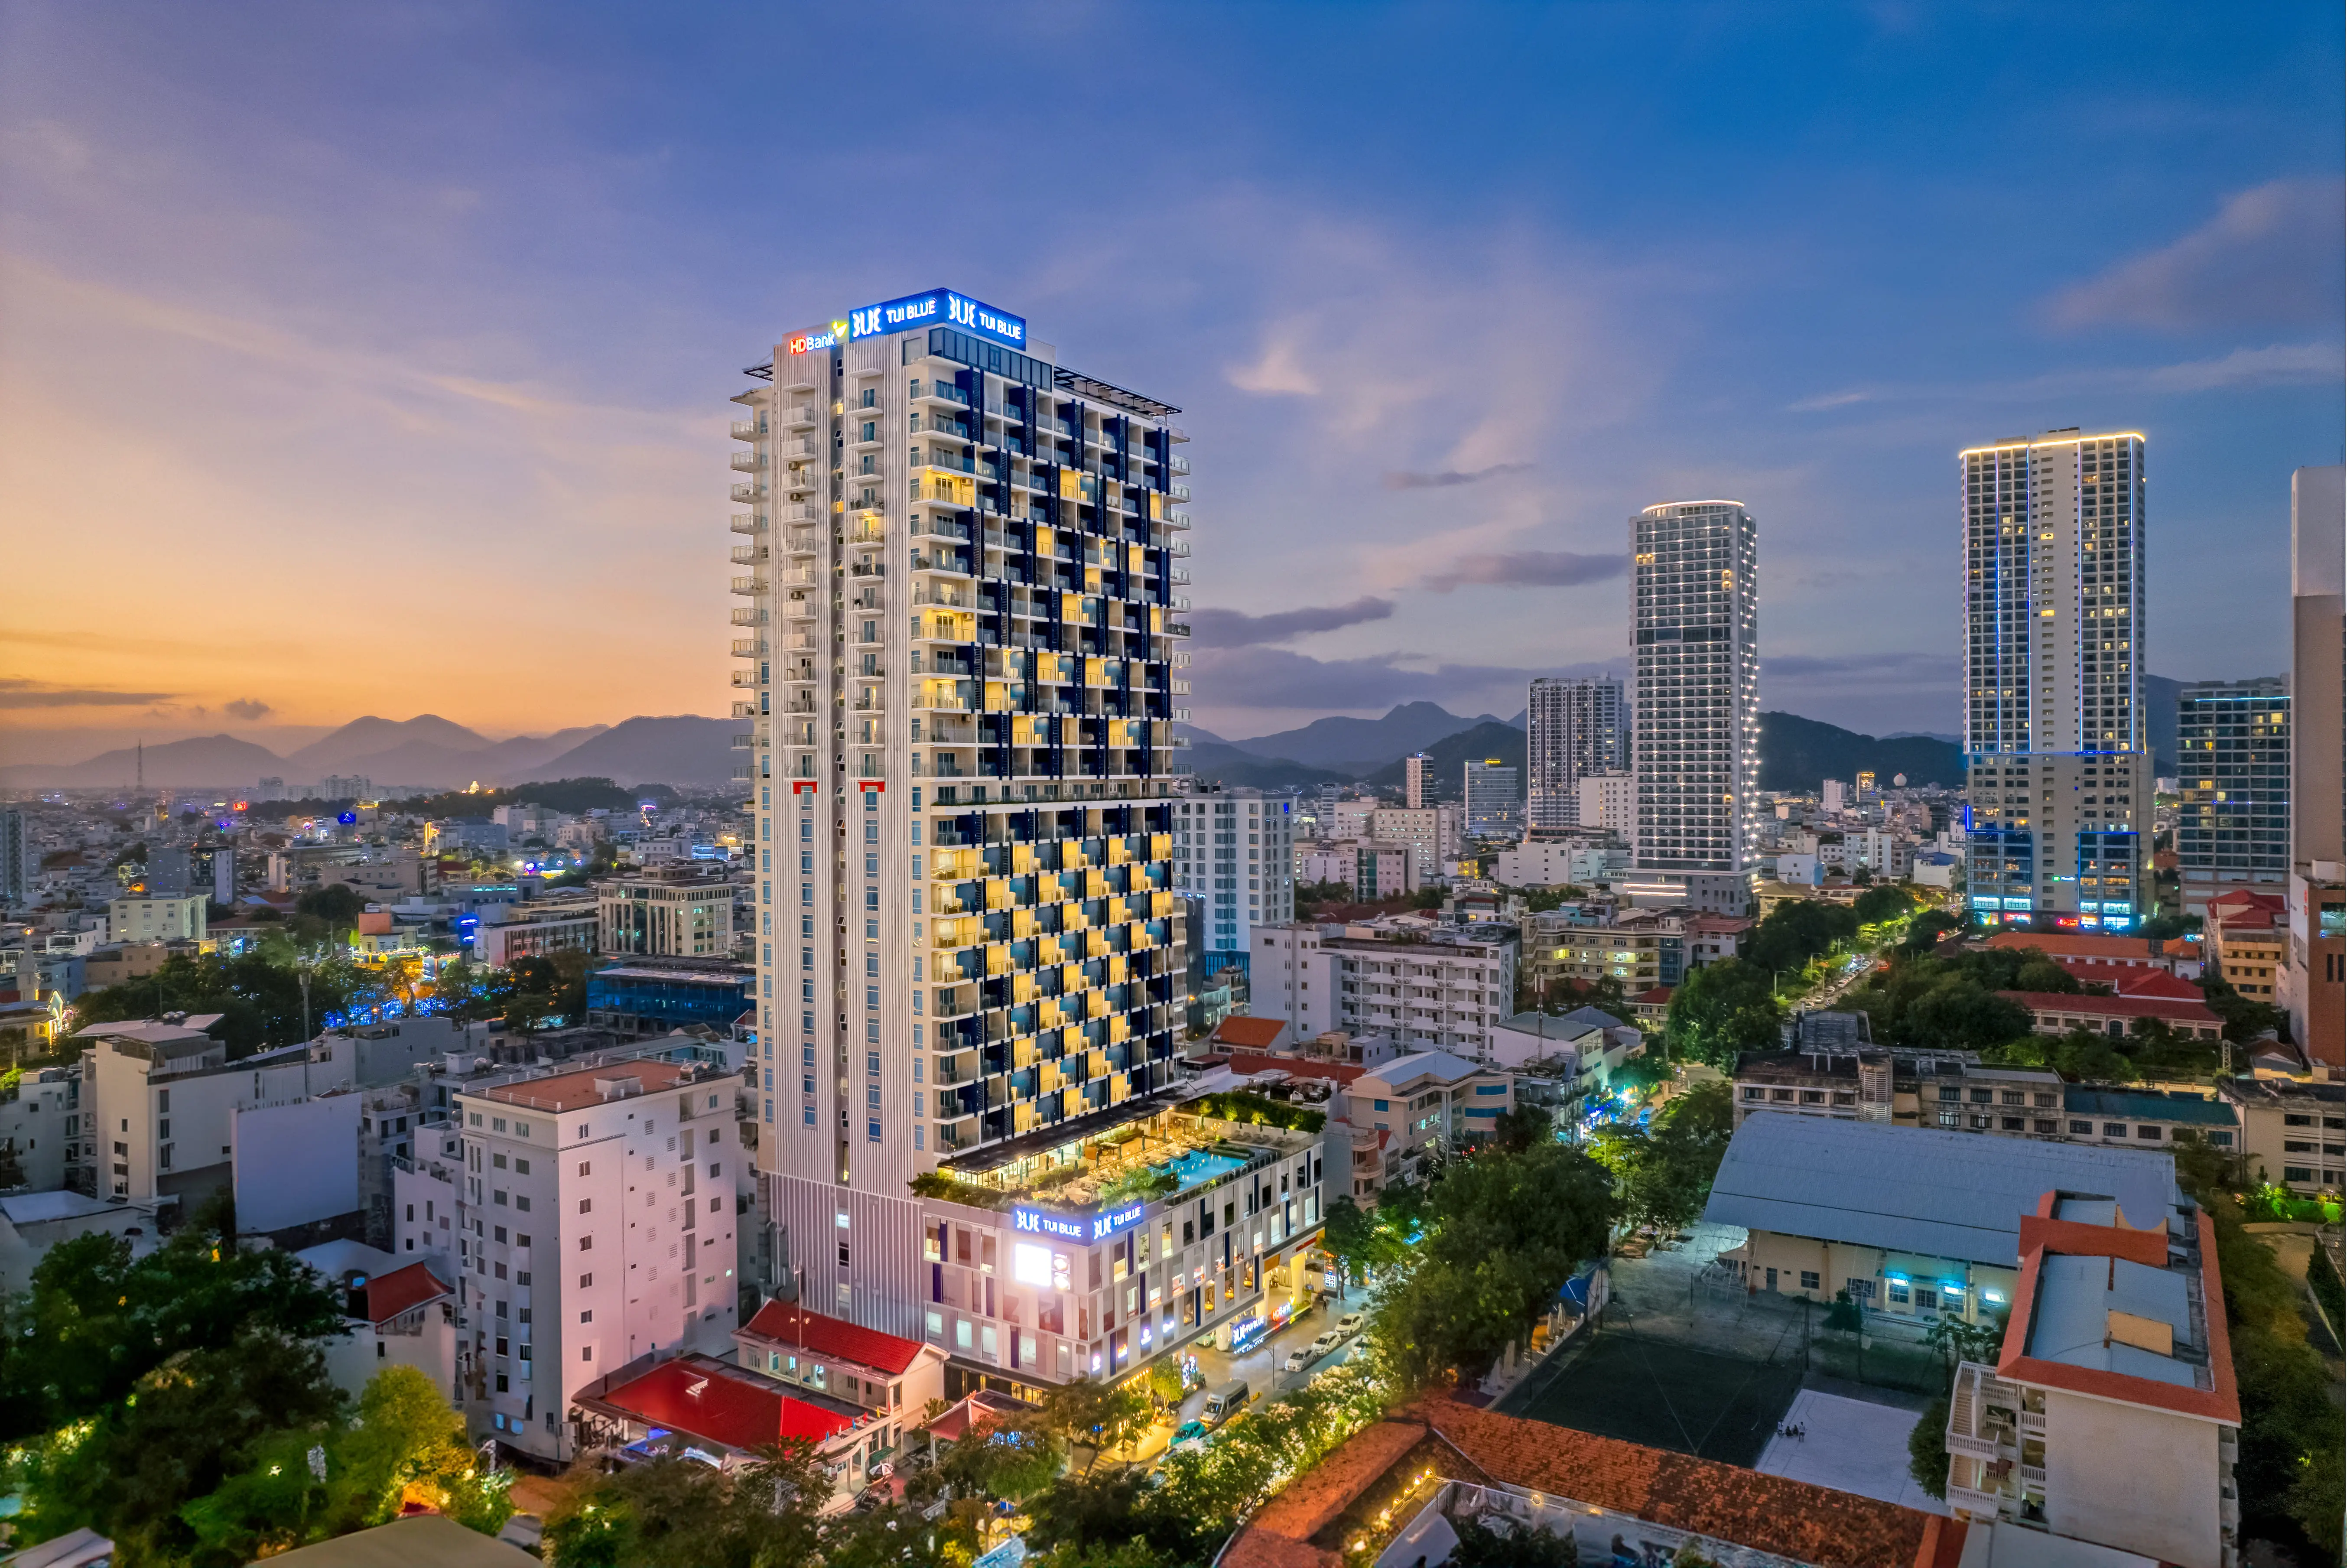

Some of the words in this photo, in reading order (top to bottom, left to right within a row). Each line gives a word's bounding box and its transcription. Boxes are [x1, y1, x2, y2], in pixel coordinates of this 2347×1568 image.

[886, 308, 904, 324] TUI
[907, 298, 936, 320] BLUE
[979, 312, 996, 330] TUI
[998, 318, 1021, 340] BLUE
[790, 332, 836, 355] HDBank
[1113, 1213, 1125, 1226] TUI
[1125, 1205, 1141, 1222] BLUE
[1043, 1219, 1057, 1232] TUI
[1059, 1222, 1081, 1237] BLUE
[1273, 1302, 1291, 1321] HDBank
